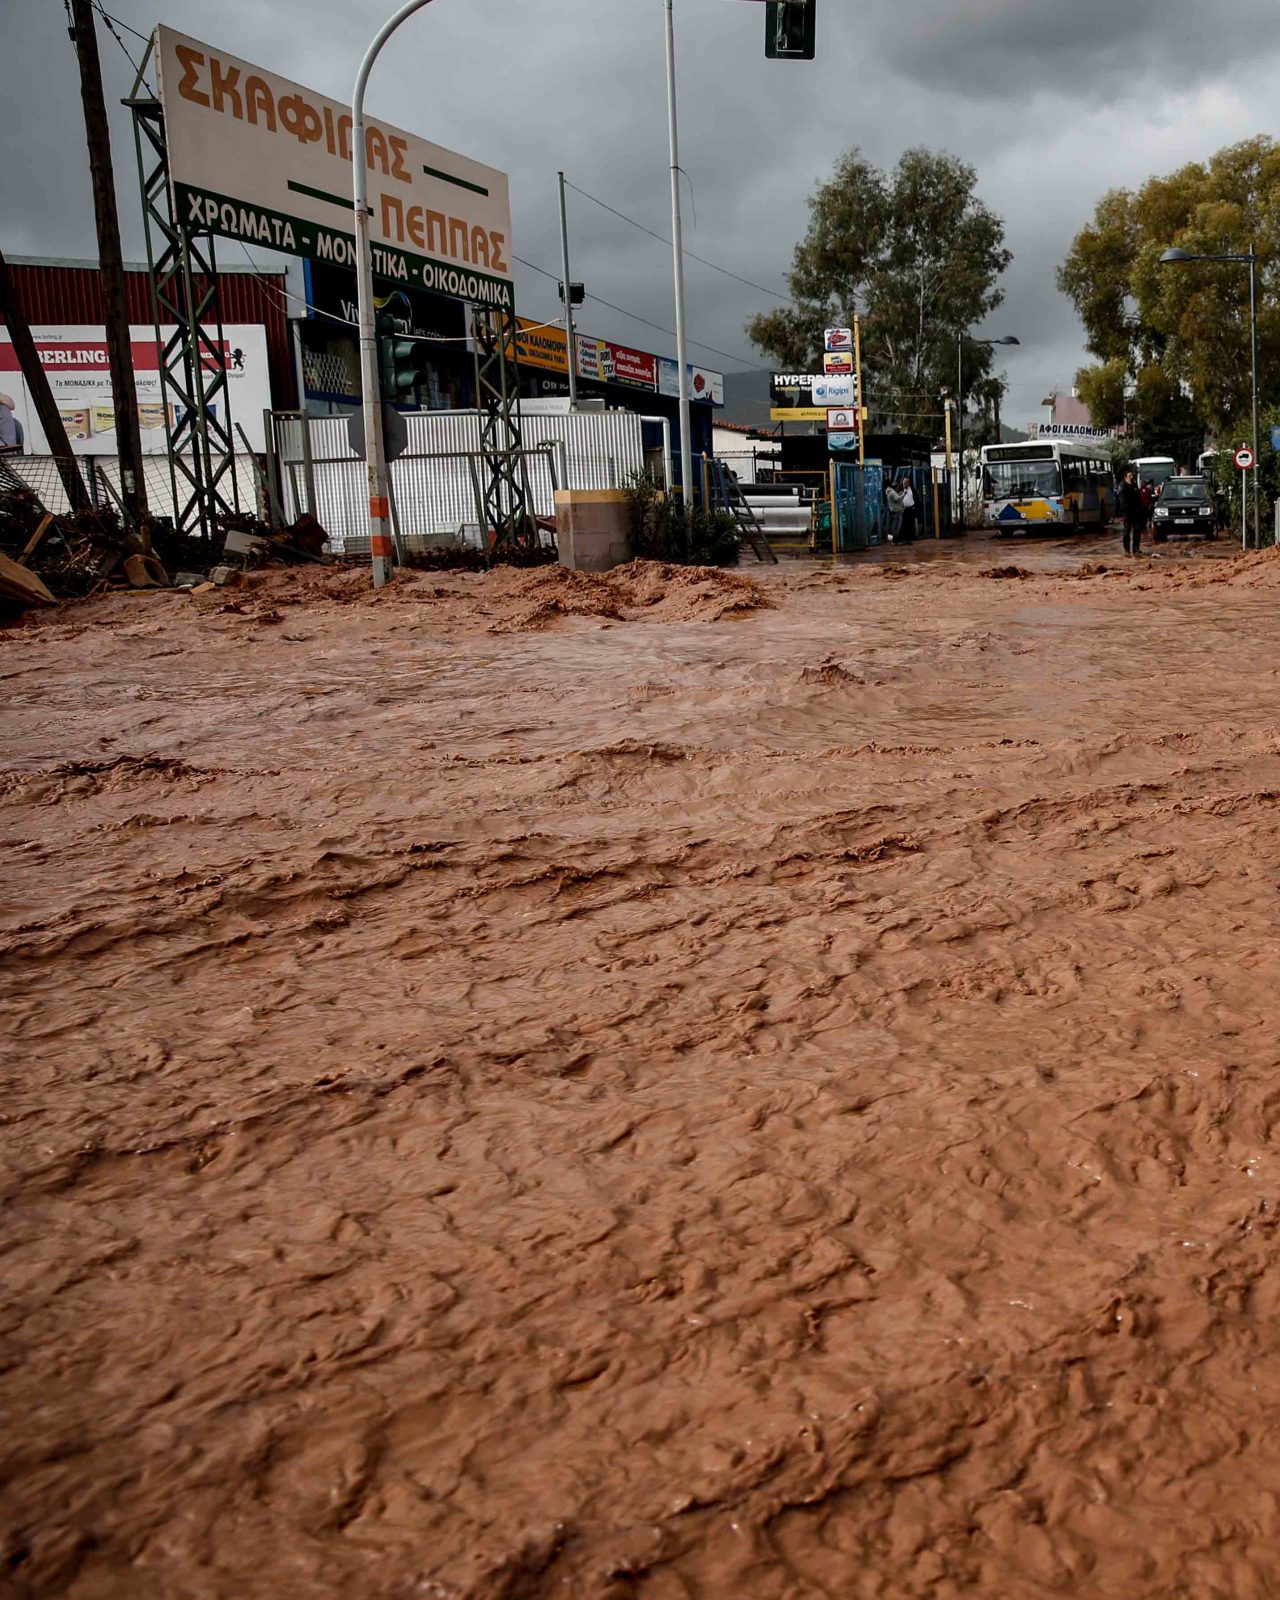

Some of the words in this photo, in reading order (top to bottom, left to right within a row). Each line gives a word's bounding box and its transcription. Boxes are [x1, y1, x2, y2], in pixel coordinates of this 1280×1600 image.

[380, 193, 508, 273] ΠΕΠΠΑΣ
[187, 192, 296, 249] ΧΡΩΜΑΤΑ
[316, 231, 408, 281] ΜΟΝΤΙΚΑ
[422, 263, 511, 306] ΟΙΚΟΔΟΜΙΚΑ
[64, 379, 95, 387] ΜΟΝΑΔΙΚΑ
[774, 374, 858, 386] HYPERO
[1039, 424, 1061, 434] ΑΦΟΙ
